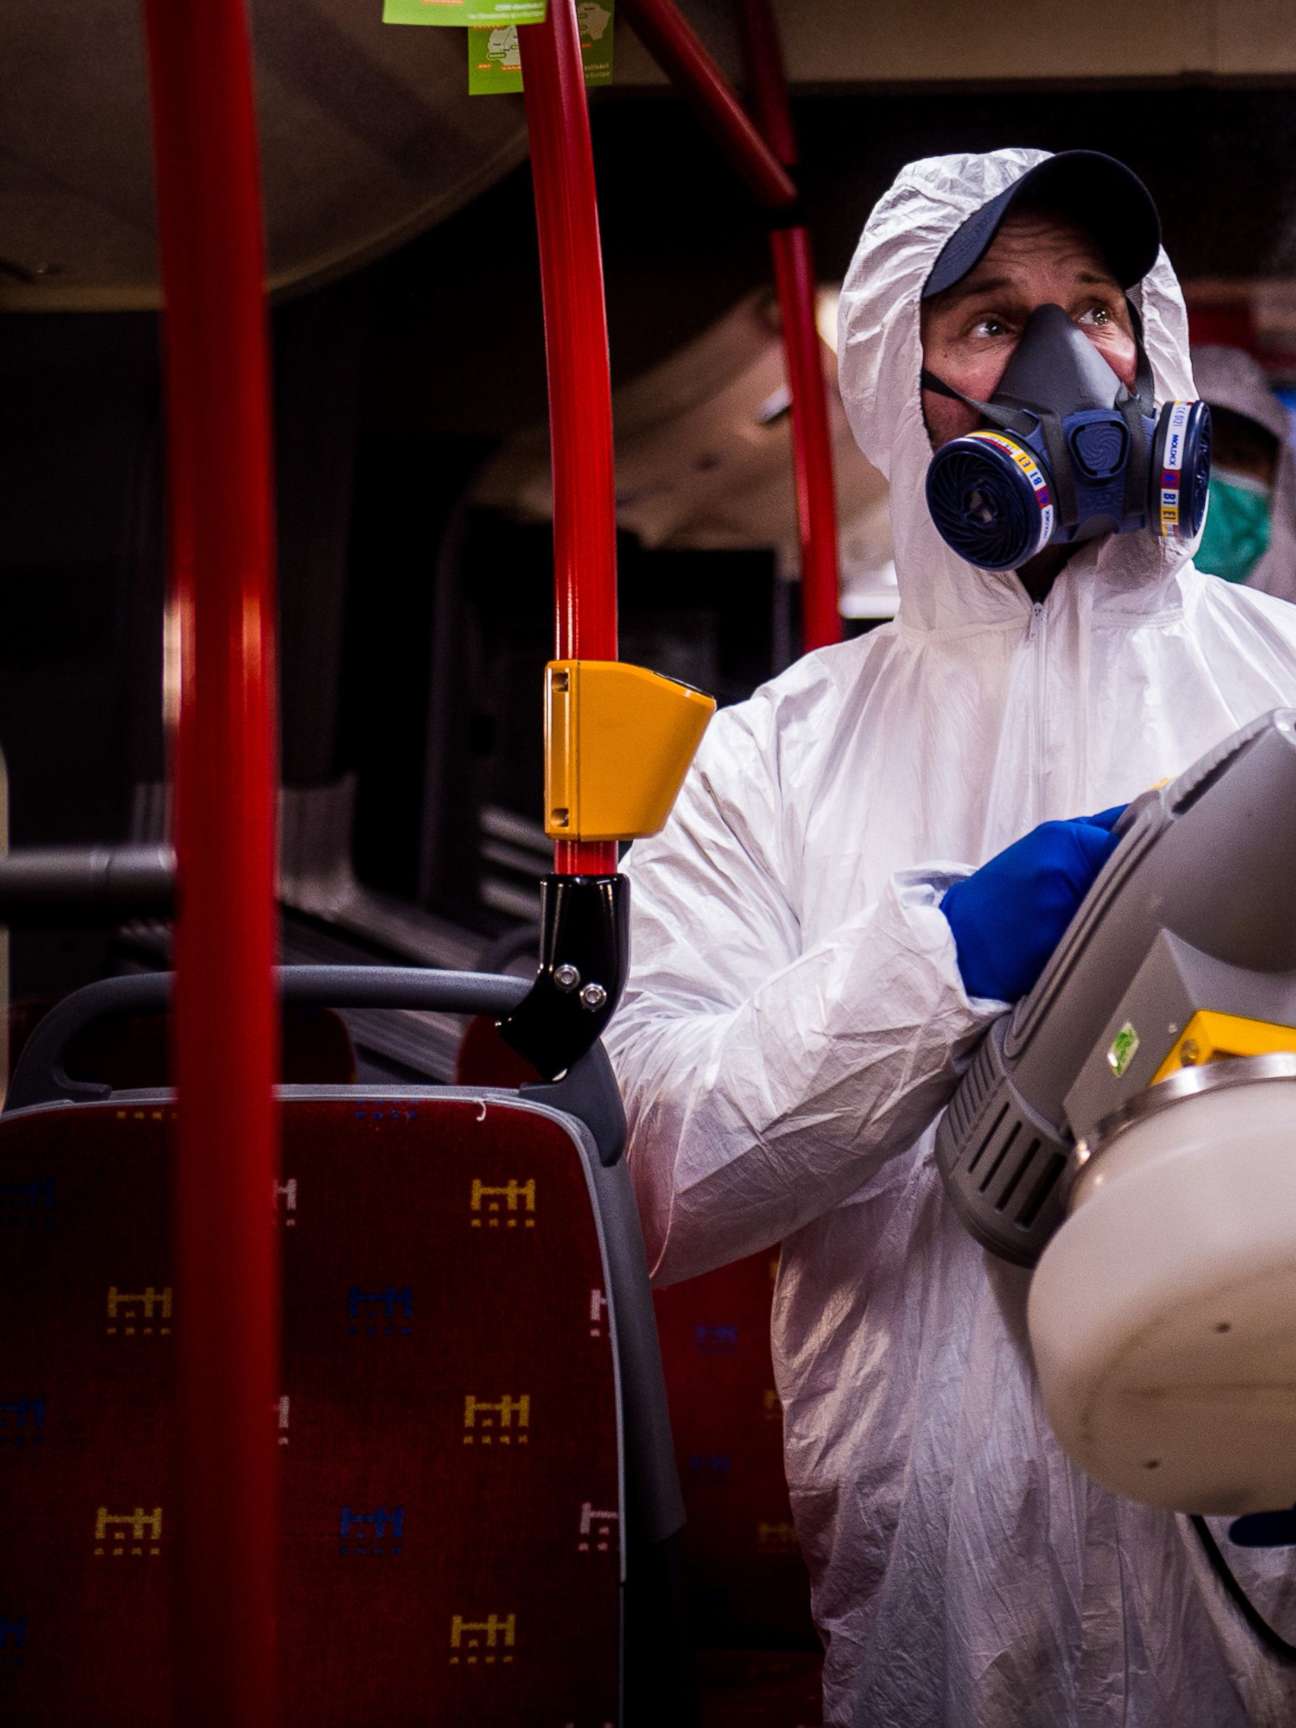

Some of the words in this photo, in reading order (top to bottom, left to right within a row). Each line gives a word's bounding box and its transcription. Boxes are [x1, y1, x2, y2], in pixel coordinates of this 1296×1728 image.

[1168, 434, 1179, 466] MOLDEX
[1163, 493, 1176, 505] B1
[1163, 511, 1176, 520] E1
